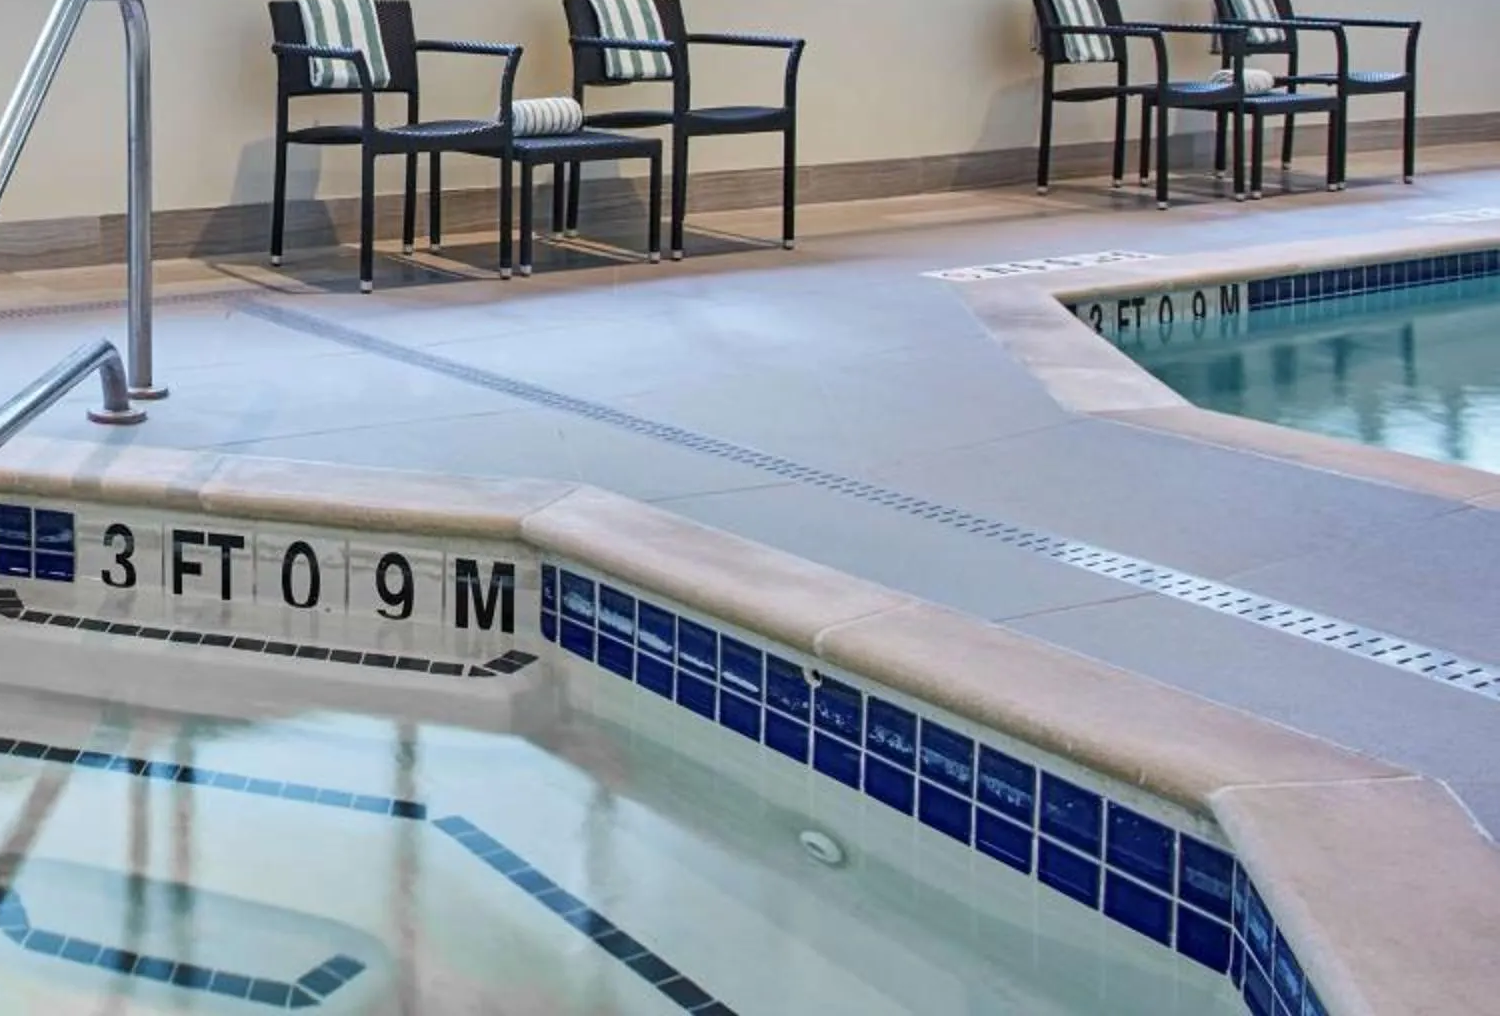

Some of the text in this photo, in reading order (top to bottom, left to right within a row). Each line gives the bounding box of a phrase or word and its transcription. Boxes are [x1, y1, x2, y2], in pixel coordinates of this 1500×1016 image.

[1117, 297, 1146, 329] FT
[1219, 283, 1240, 316] M
[100, 522, 137, 589] 3
[171, 529, 245, 601] FT
[454, 557, 516, 635] M
